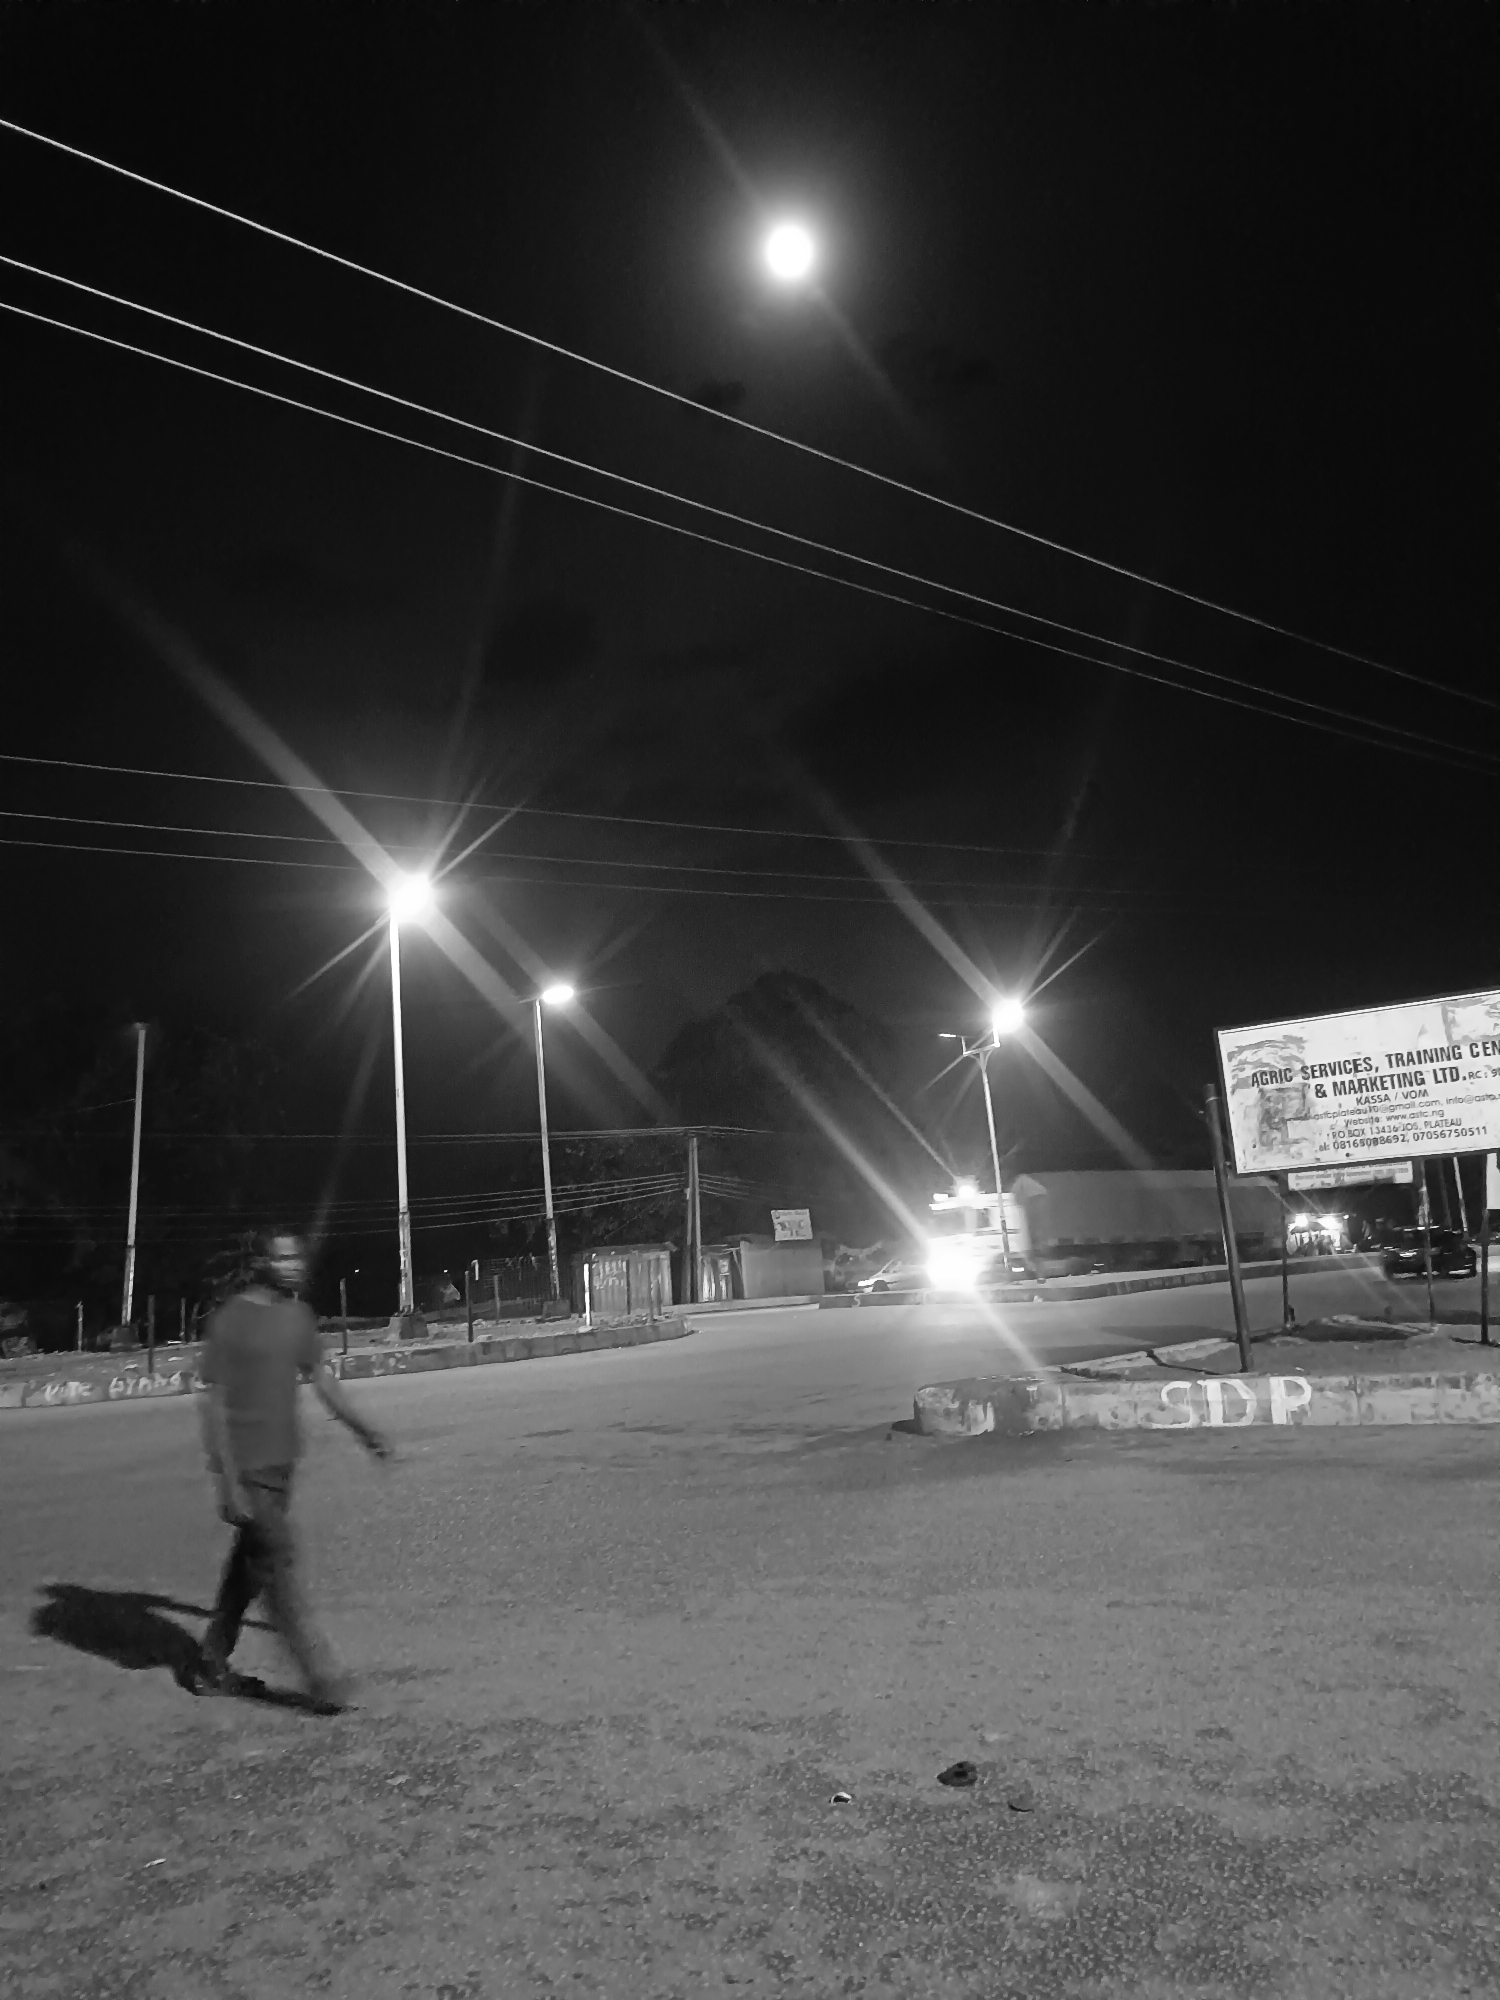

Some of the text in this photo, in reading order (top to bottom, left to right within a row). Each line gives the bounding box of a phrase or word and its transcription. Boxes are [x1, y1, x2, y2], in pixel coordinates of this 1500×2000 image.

[1251, 1067, 1293, 1088] AGRIC
[1300, 1057, 1379, 1081] SERVICES,
[1385, 1044, 1463, 1069] TRAINING
[1315, 1083, 1328, 1099] &
[1332, 1070, 1426, 1097] MARKETING
[1432, 1066, 1467, 1085] LTD.
[1355, 1093, 1391, 1106] KASSA
[1401, 1088, 1429, 1100] VOM
[1412, 1125, 1487, 1142] 07056750511
[1424, 1117, 1462, 1129] PLATEAU
[1150, 1376, 1312, 1428] SDP
